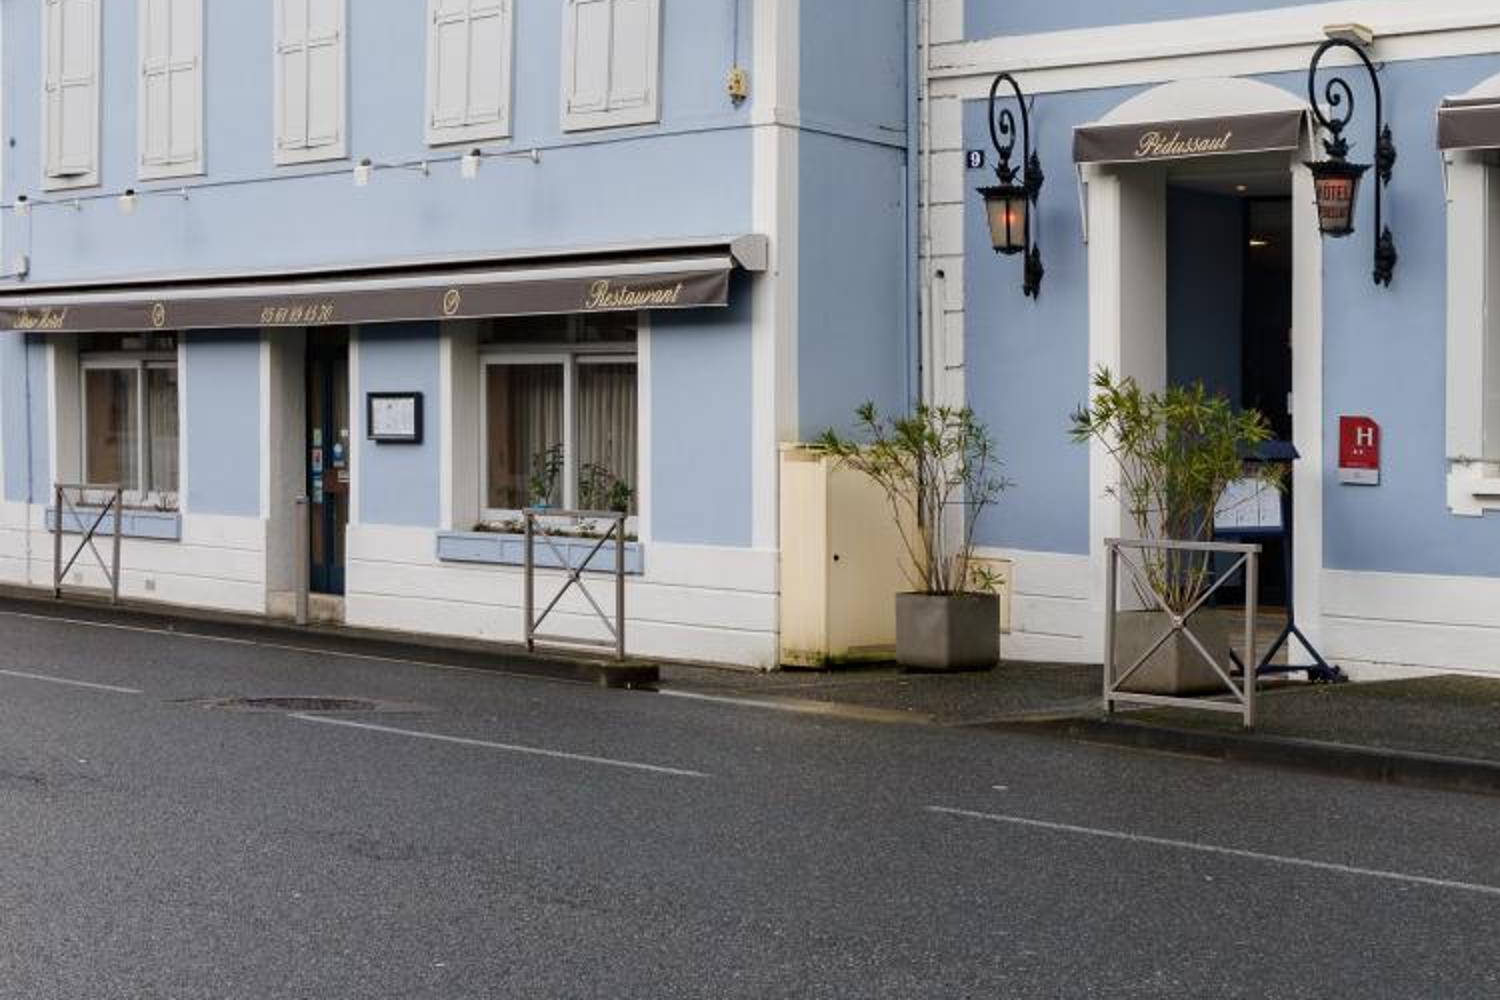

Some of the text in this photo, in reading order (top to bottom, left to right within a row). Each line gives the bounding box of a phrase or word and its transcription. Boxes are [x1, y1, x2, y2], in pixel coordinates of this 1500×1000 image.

[1136, 131, 1232, 156] Pédussaut
[971, 151, 981, 166] 9
[585, 280, 683, 309] Restaurant
[1357, 427, 1373, 446] H
